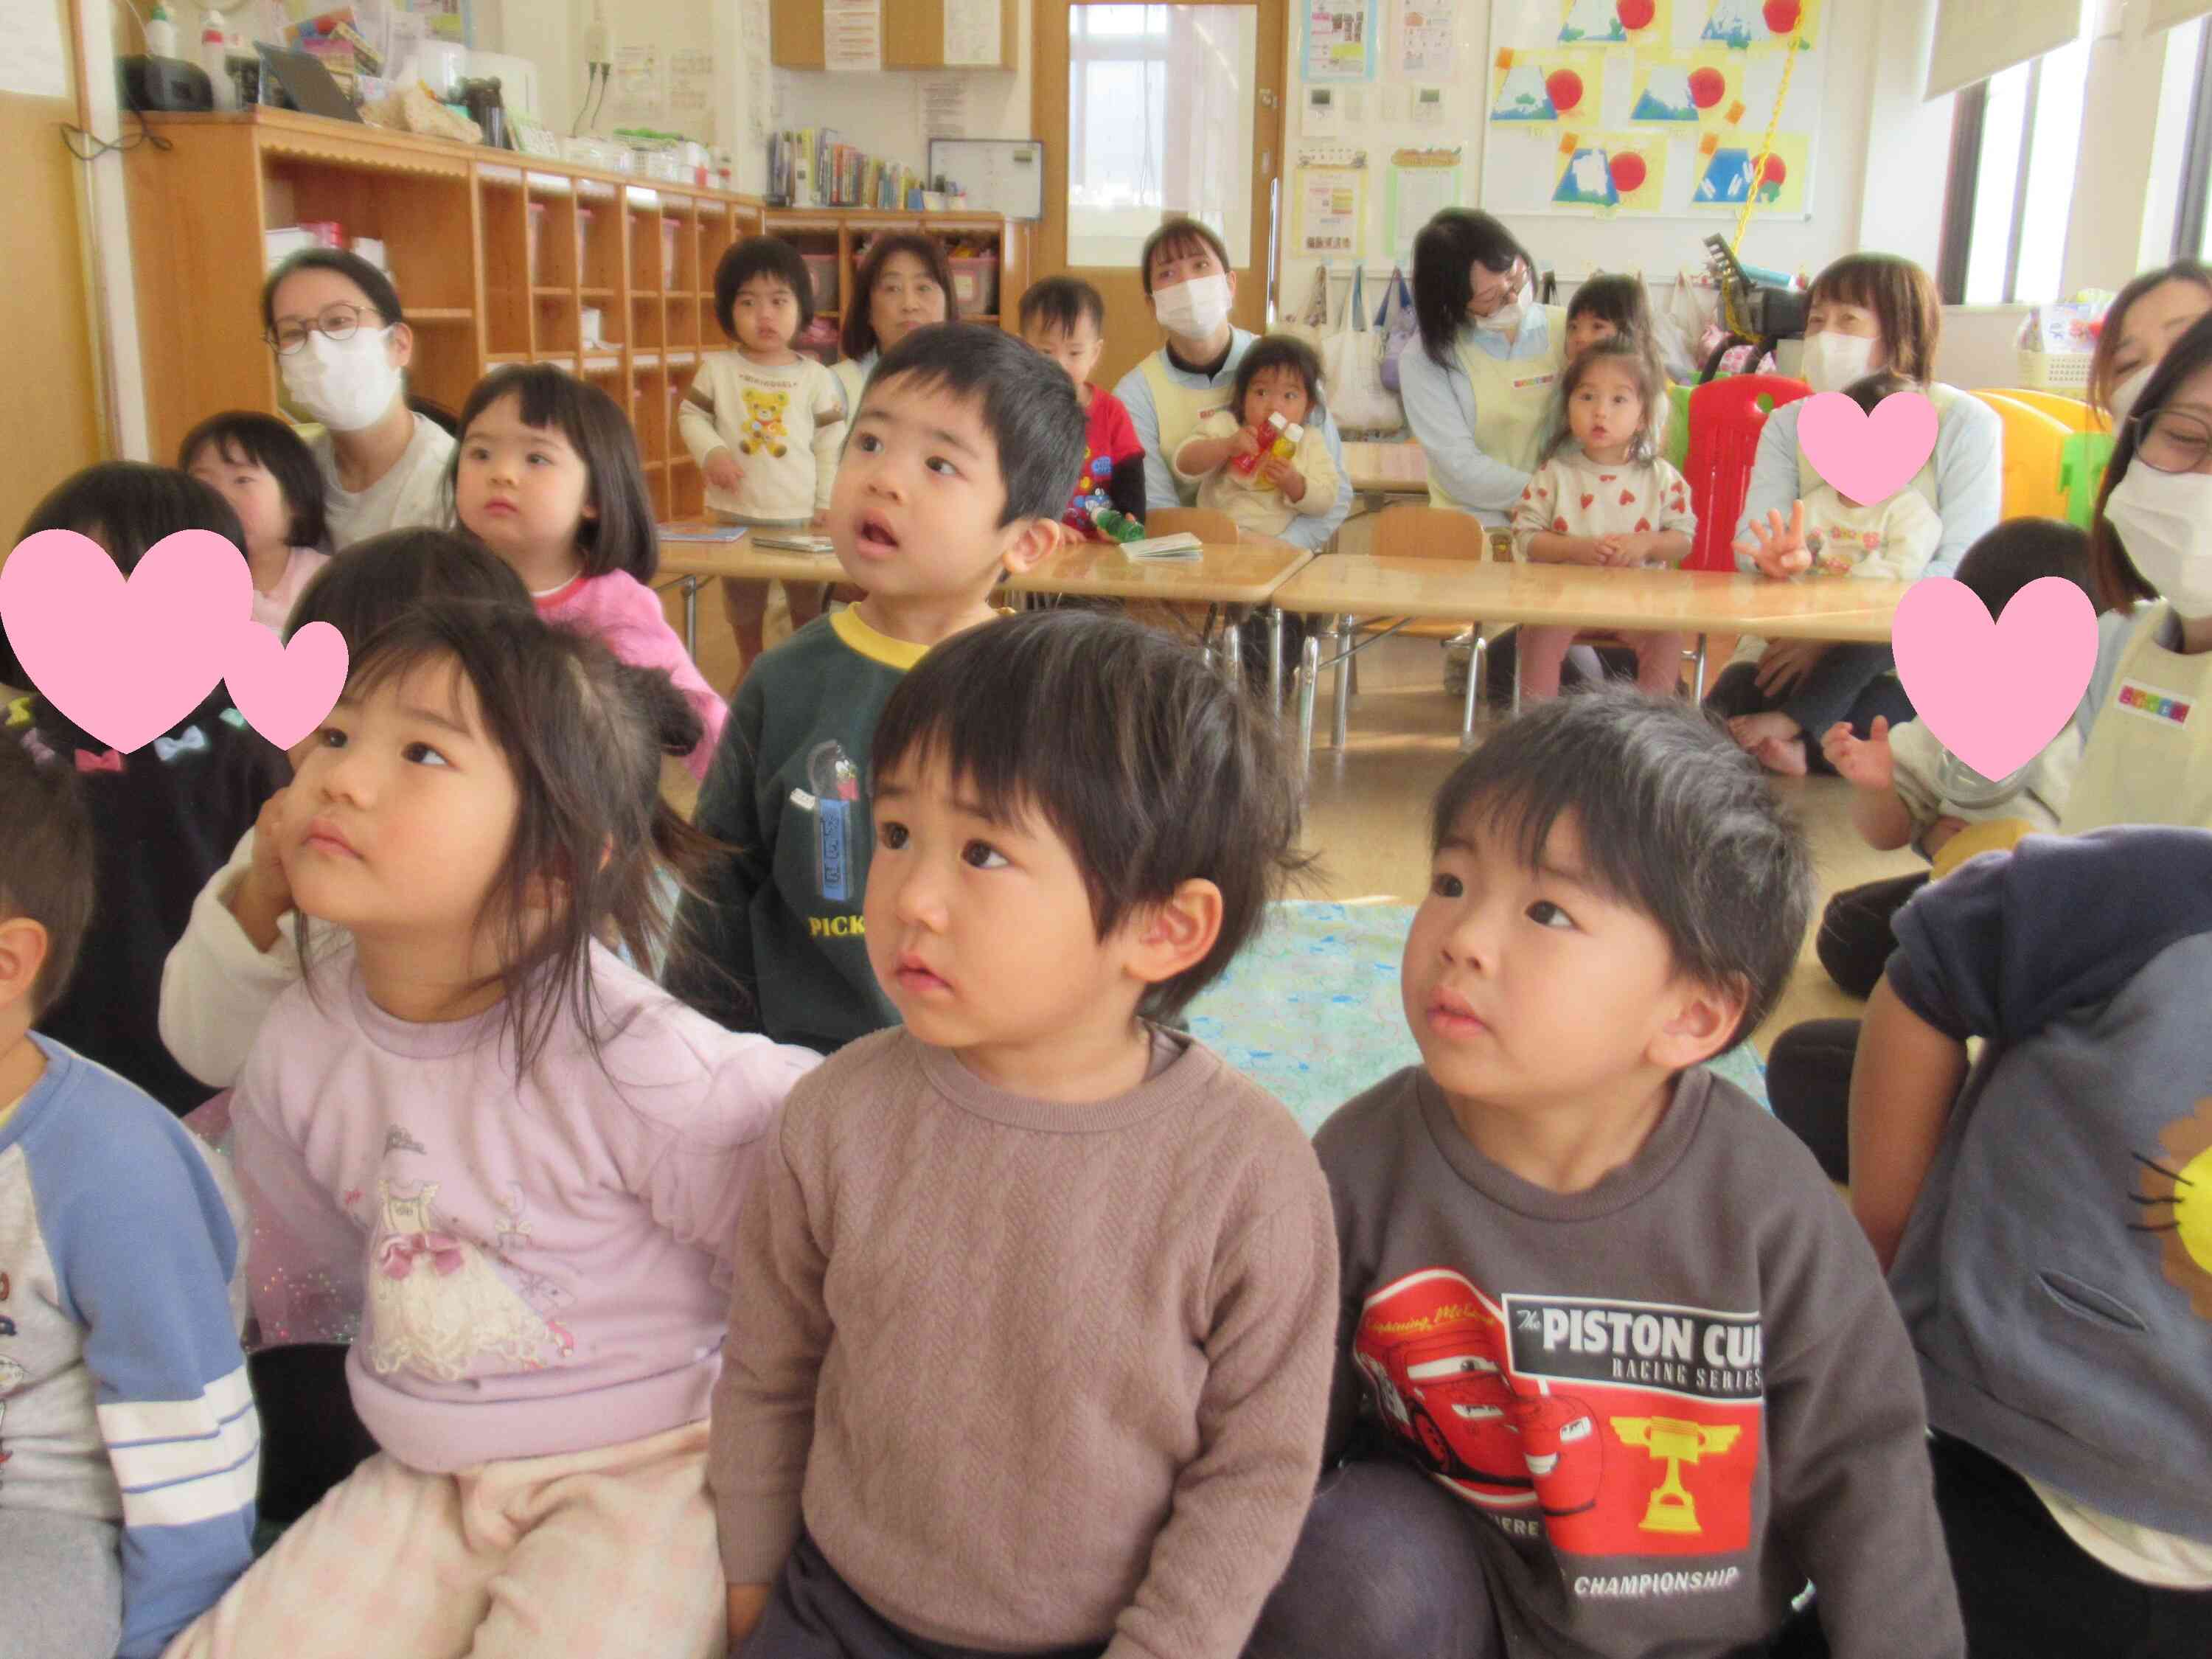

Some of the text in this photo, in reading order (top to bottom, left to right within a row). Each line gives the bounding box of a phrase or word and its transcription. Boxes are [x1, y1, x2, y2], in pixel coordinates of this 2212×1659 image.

[1516, 1309, 1542, 1329] The
[1543, 1307, 1694, 1360] PISTON
[1612, 1357, 1761, 1391] RACING SERIES
[1573, 1565, 1738, 1596] CHAMPIONSHIP
